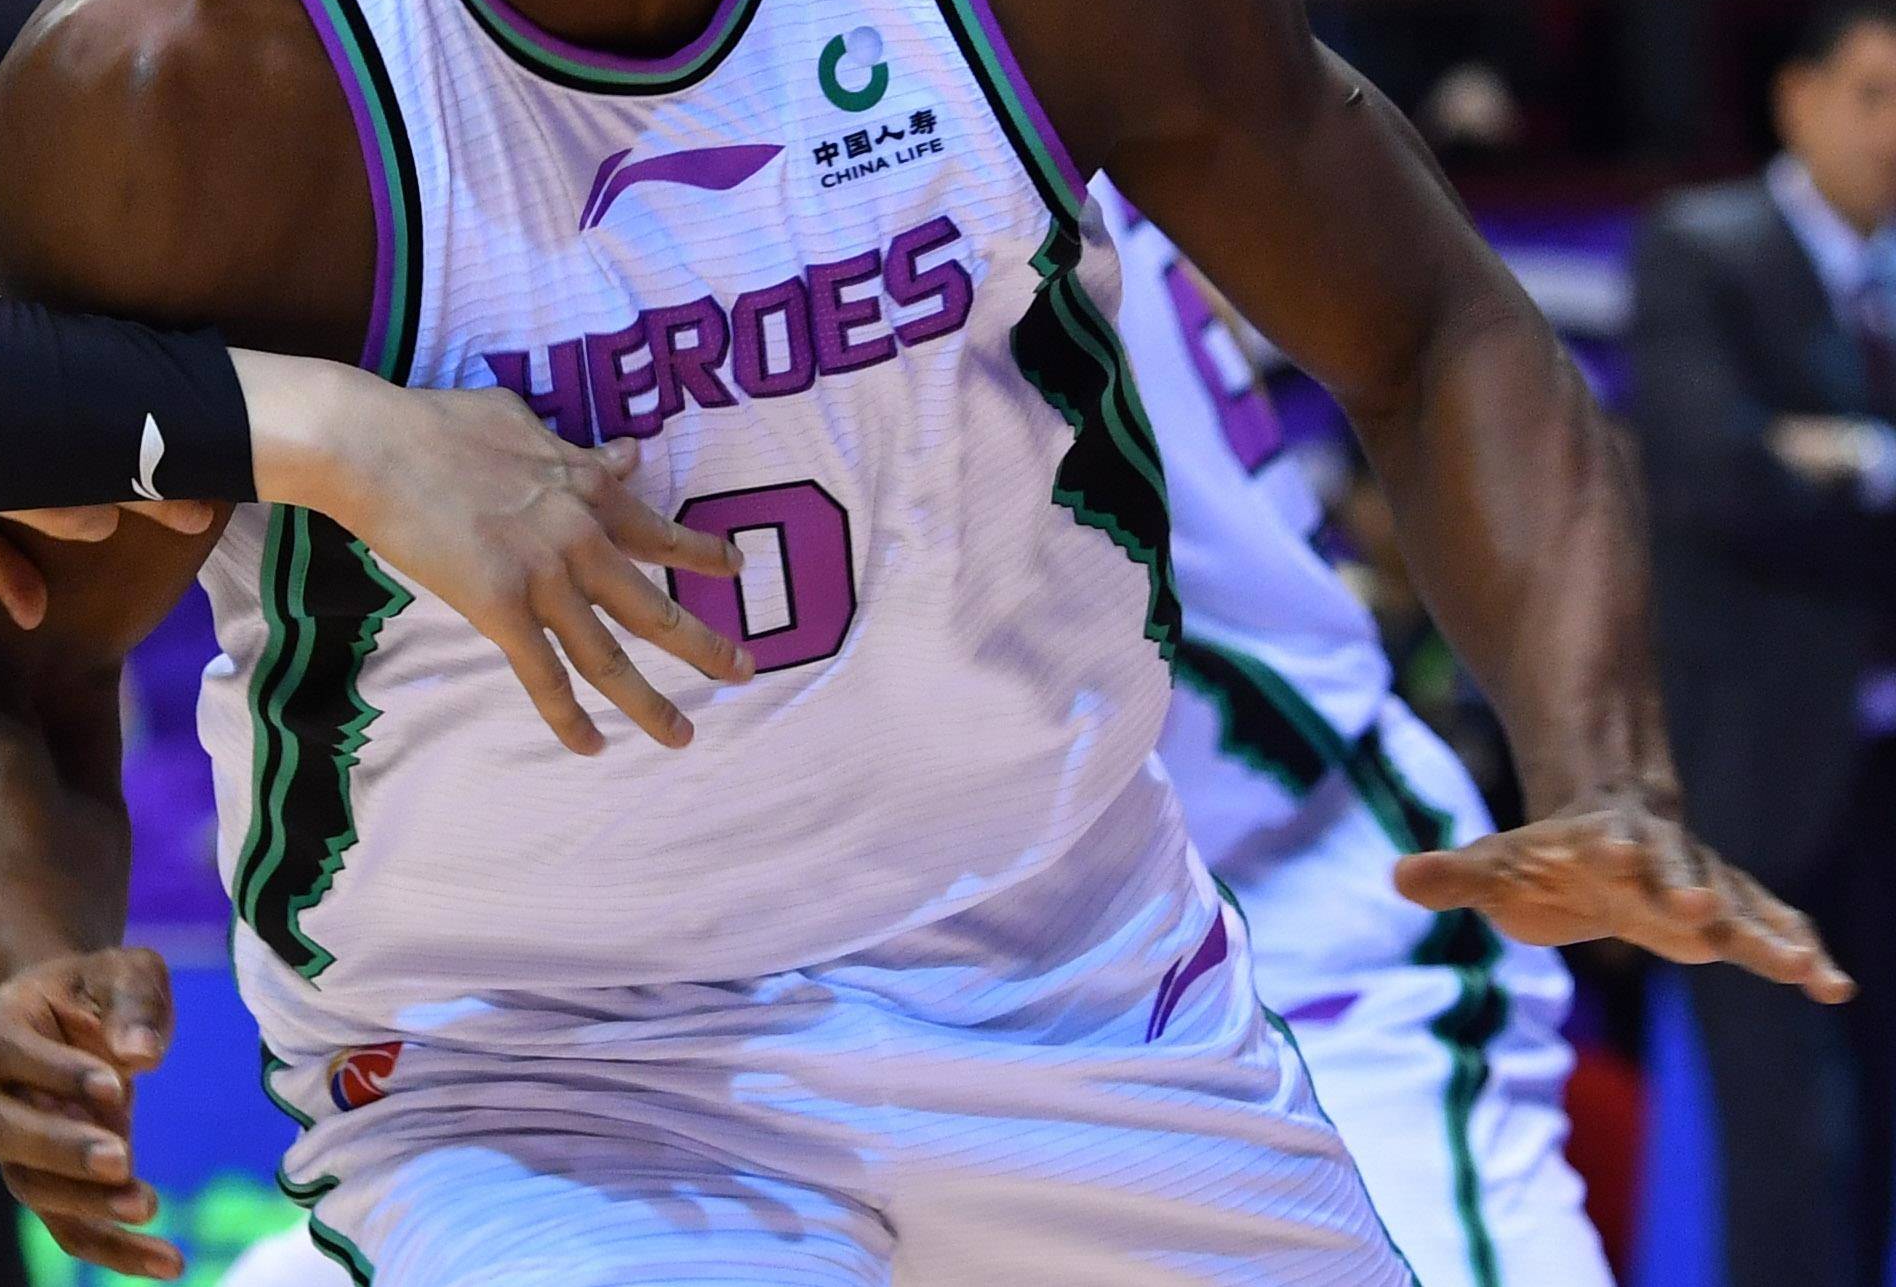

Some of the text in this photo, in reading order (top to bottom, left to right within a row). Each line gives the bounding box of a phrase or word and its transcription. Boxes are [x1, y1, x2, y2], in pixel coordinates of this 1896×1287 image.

[812, 109, 937, 167] 中国人寿
[820, 138, 945, 188] CHINA LIFE
[485, 215, 974, 448] HEROES
[665, 479, 858, 677] 0
